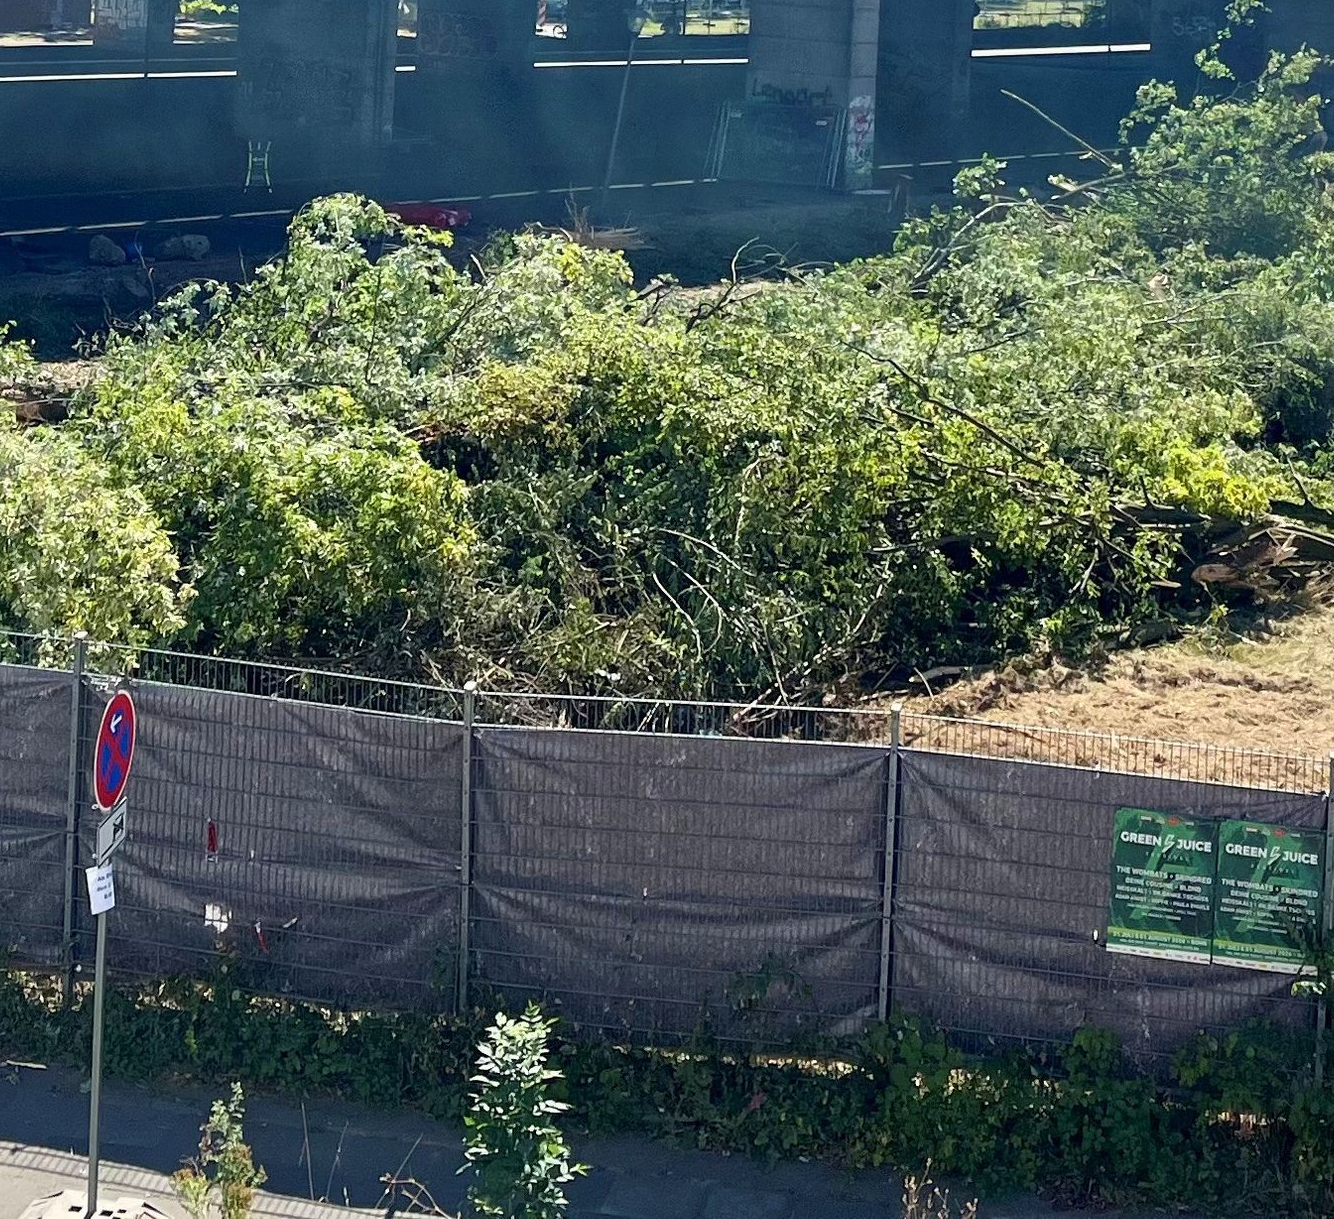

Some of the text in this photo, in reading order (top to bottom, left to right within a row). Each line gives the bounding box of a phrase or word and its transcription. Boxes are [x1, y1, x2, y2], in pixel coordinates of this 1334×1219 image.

[1120, 831, 1212, 853] GREEN JUICE
[1225, 843, 1318, 865] GREEN JUICE
[1116, 865, 1131, 875] THE
[1131, 867, 1168, 879] WOMBATS
[1221, 878, 1235, 887] THE
[1236, 880, 1273, 892] WOMBATS
